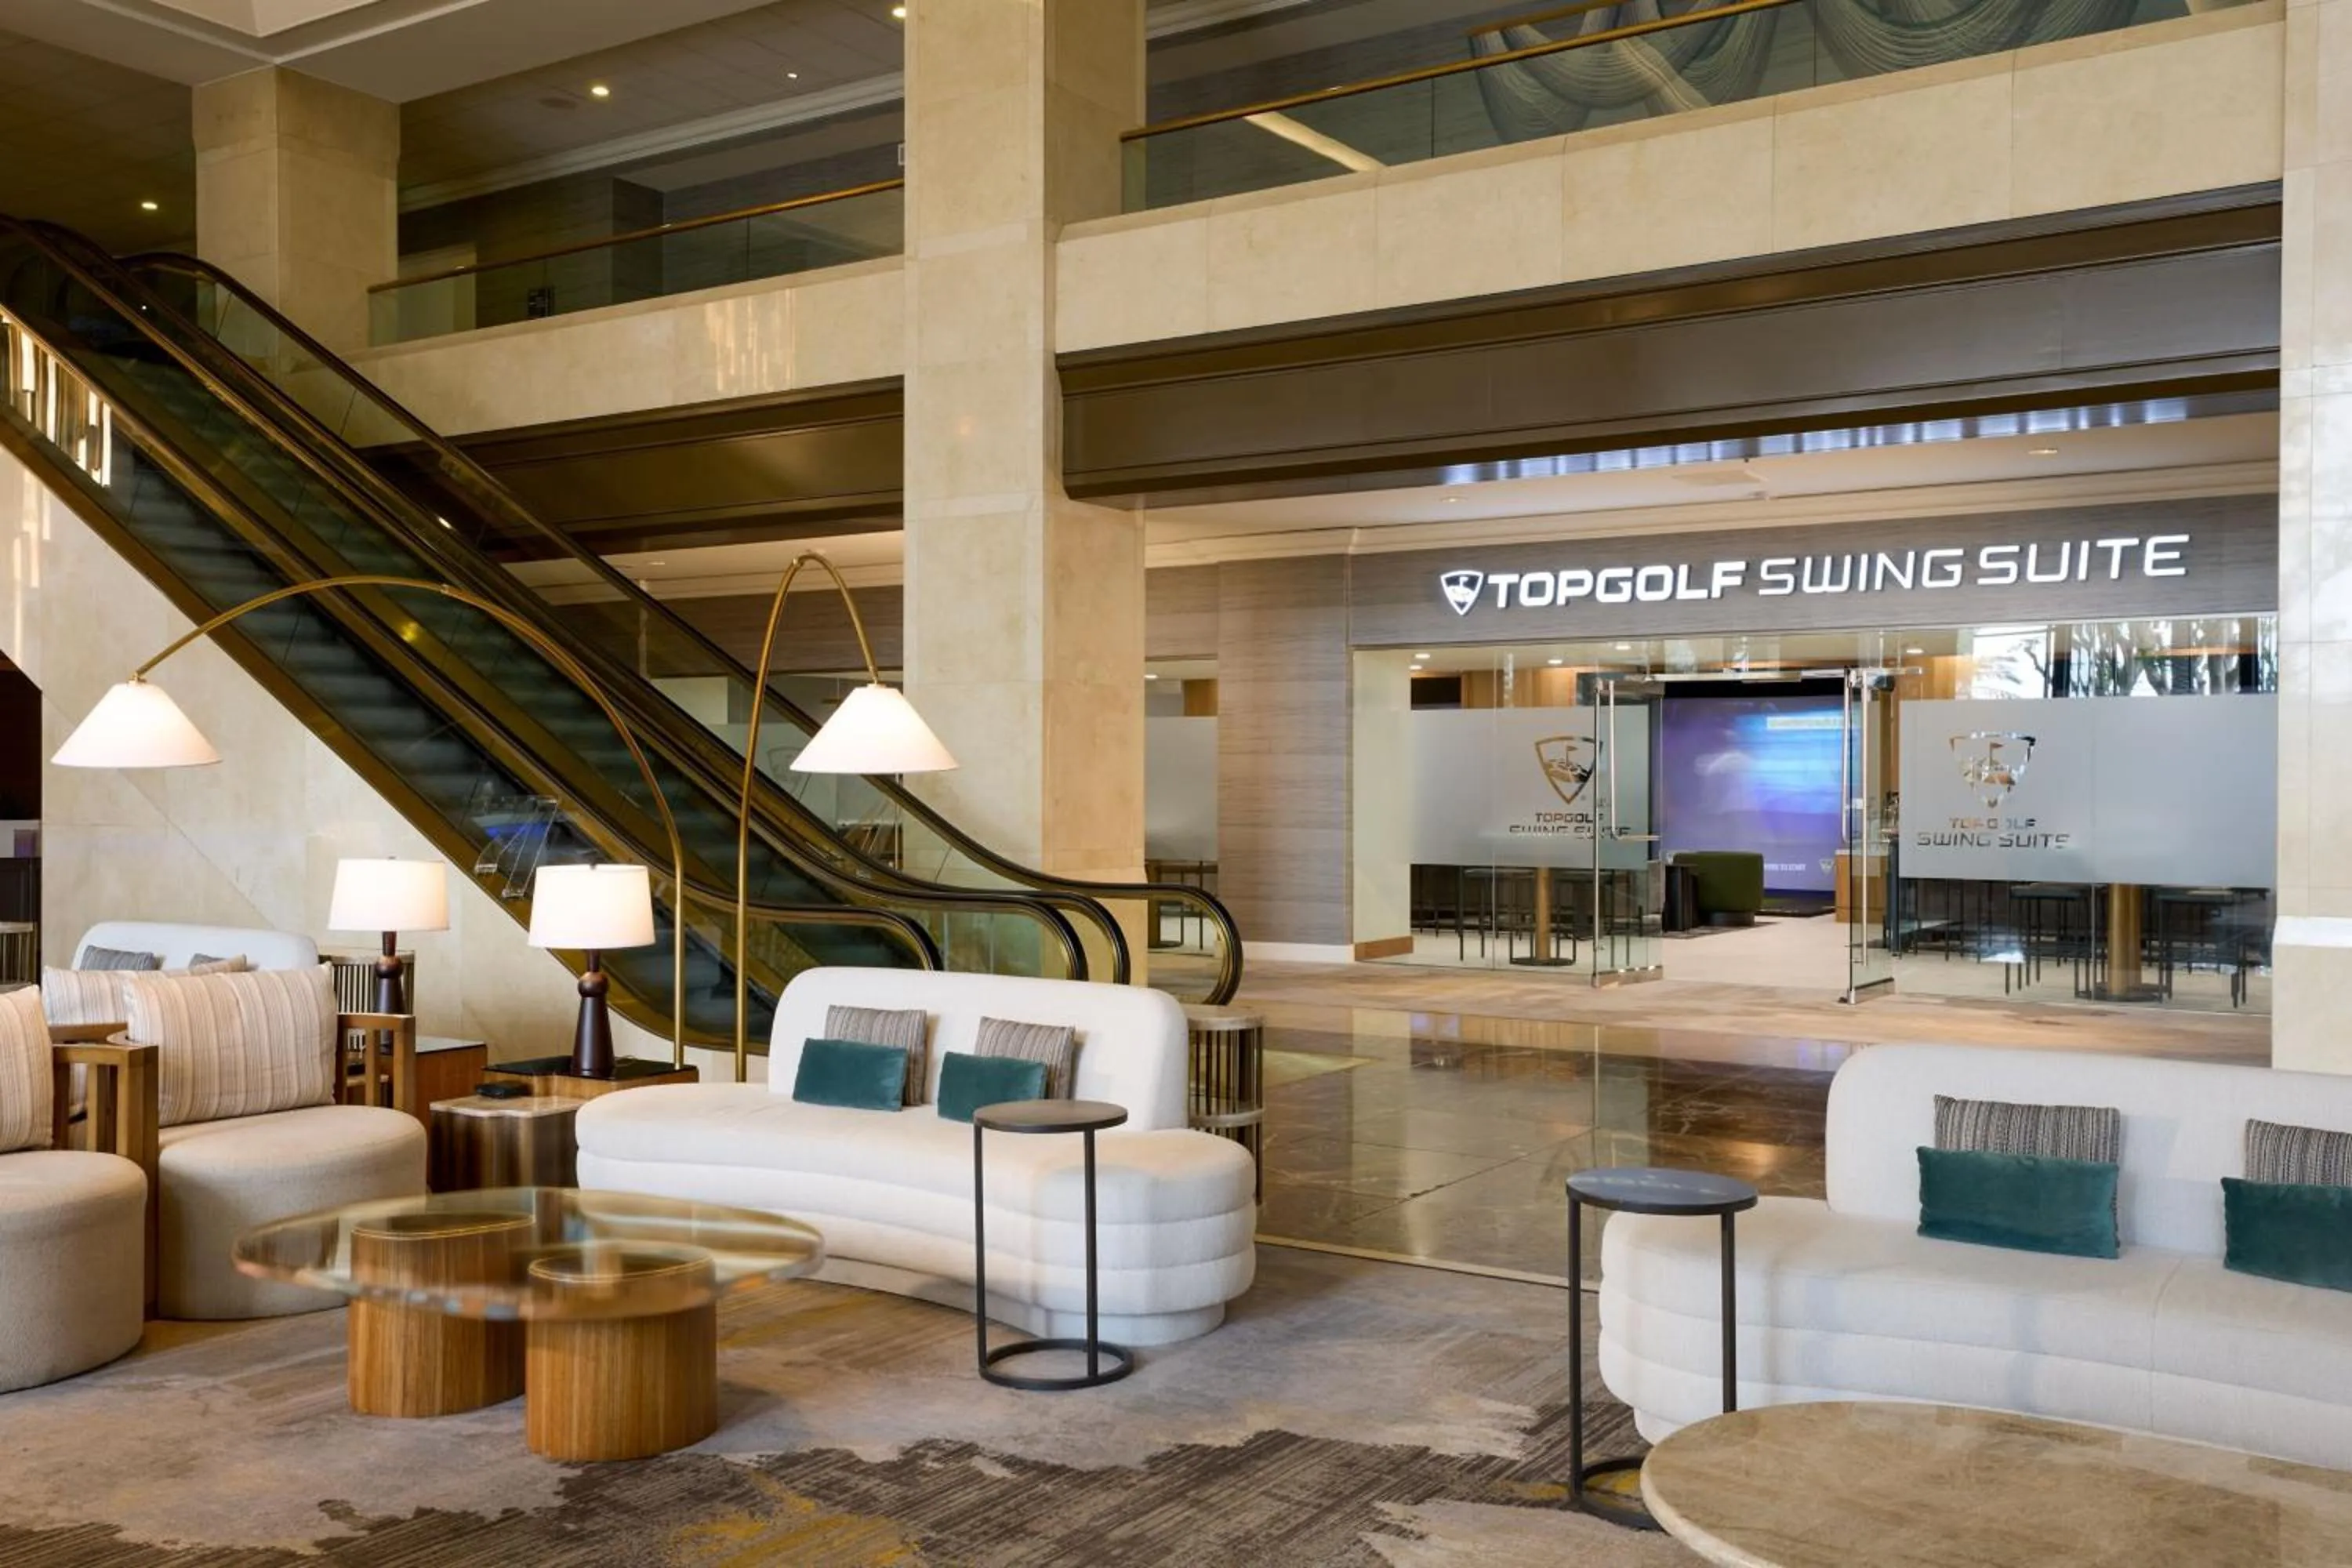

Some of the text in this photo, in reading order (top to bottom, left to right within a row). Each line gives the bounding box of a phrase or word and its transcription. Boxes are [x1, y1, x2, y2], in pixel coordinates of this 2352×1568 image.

[1487, 534, 2190, 608] TOPGOLF SWING SUITE
[1917, 832, 2070, 849] SWING SUITE
